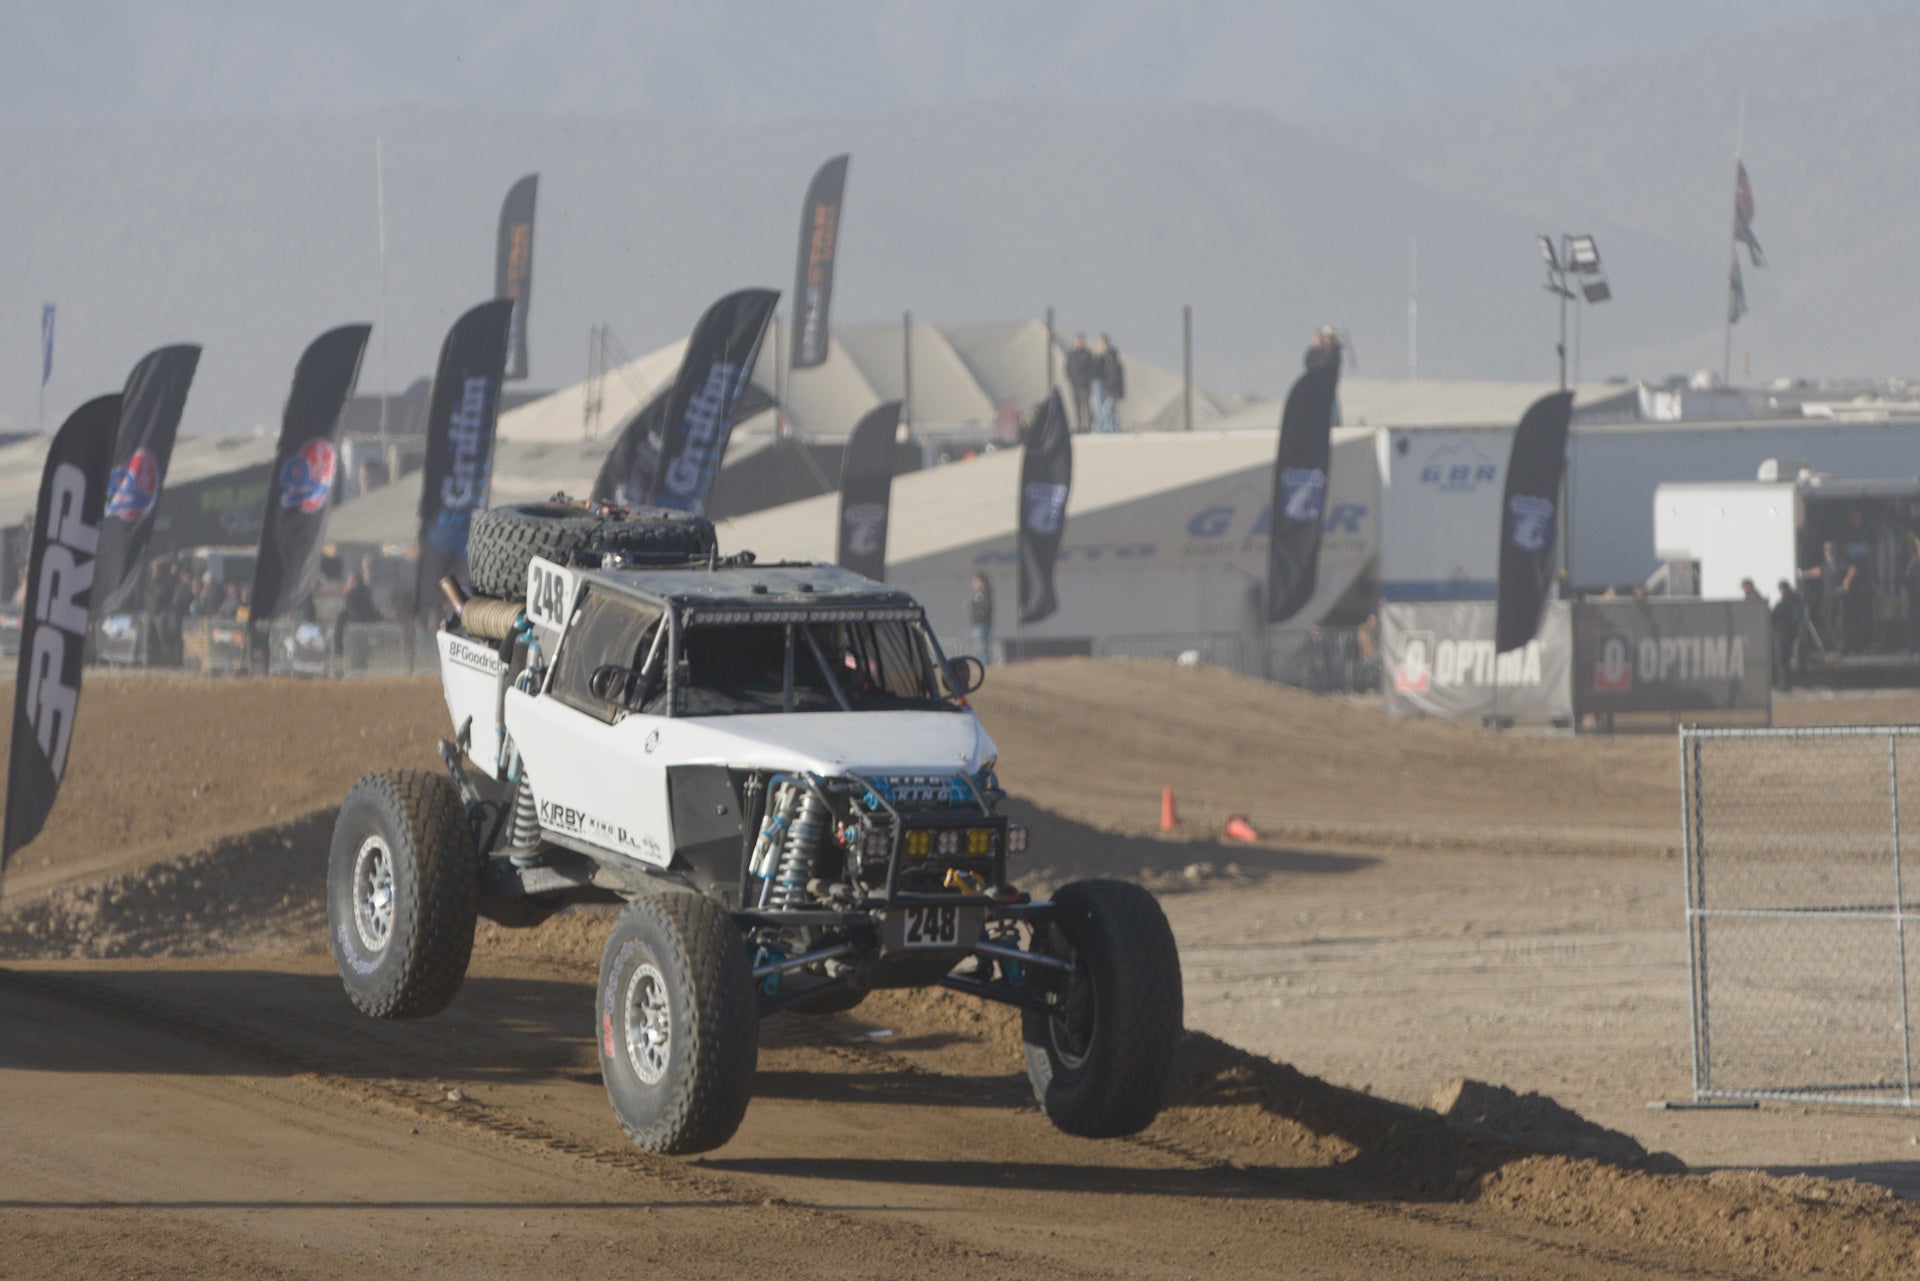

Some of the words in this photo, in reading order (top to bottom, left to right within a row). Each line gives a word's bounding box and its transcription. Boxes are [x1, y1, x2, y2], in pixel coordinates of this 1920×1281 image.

[533, 565, 565, 625] 248
[1638, 634, 1747, 683] OPTIMA
[540, 798, 586, 833] KIRBY
[906, 906, 957, 943] 248
